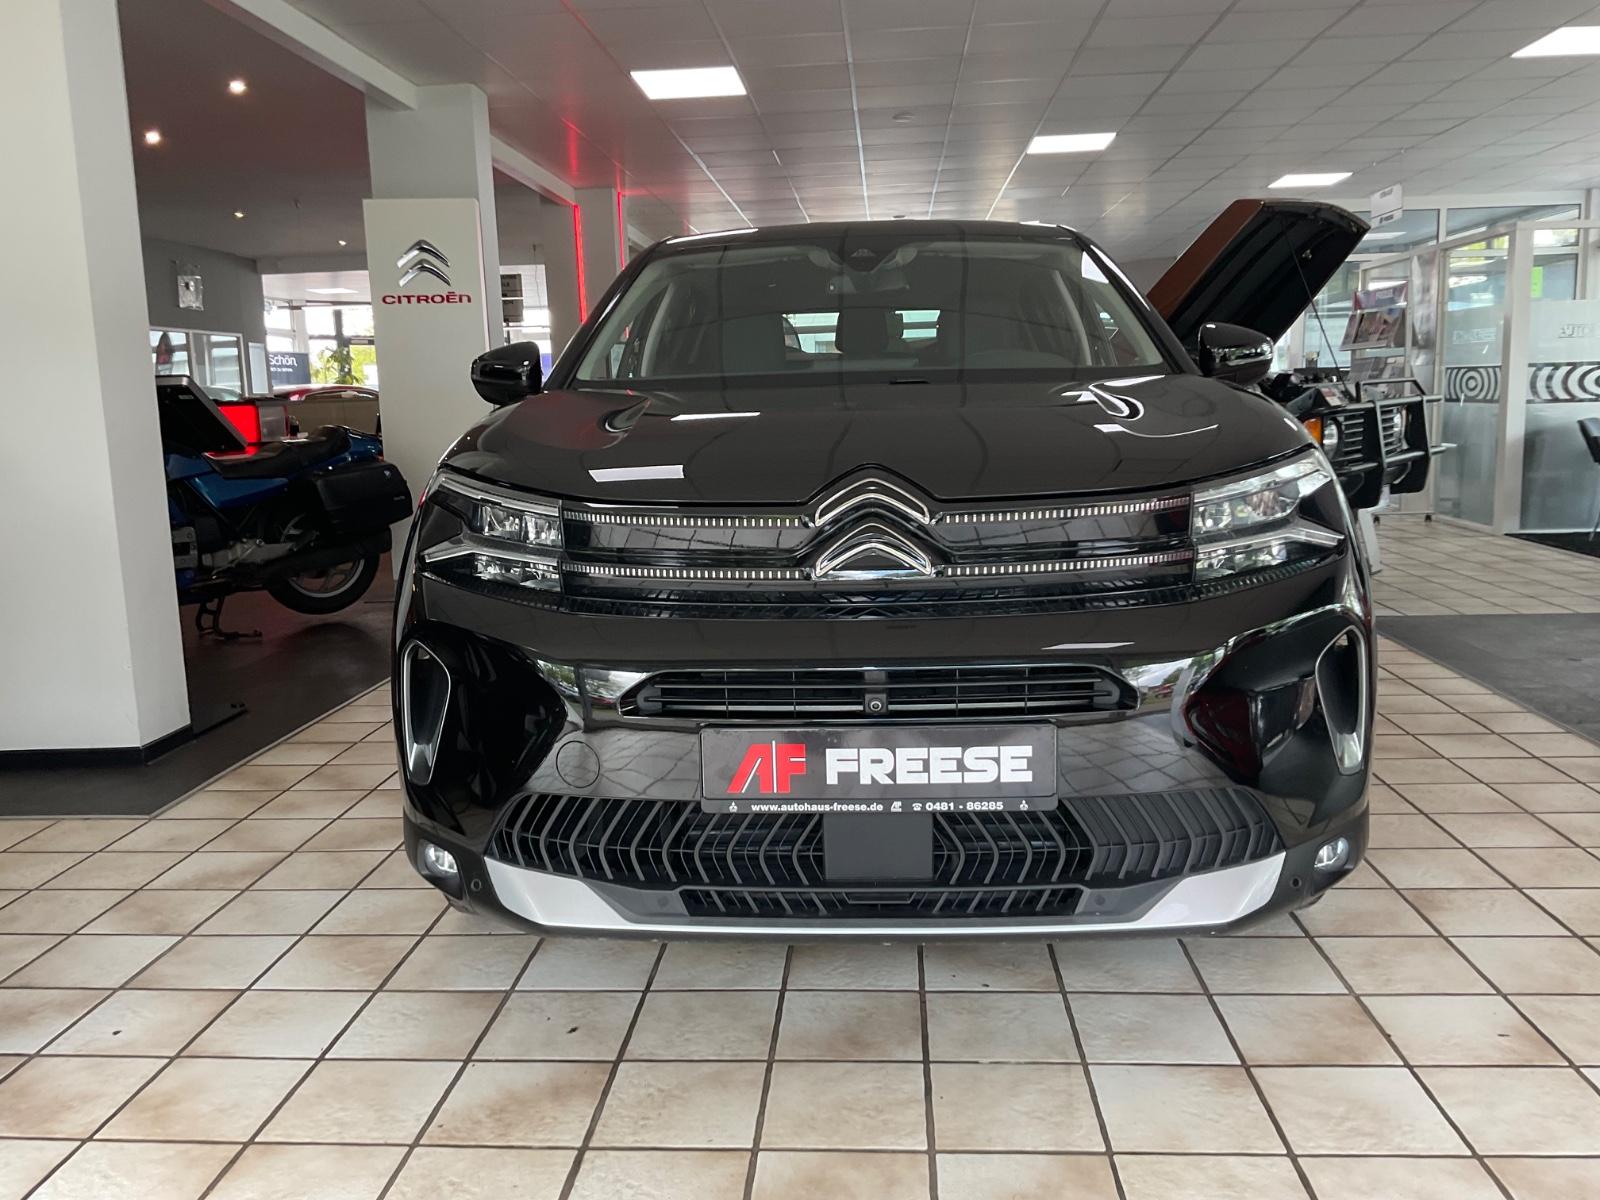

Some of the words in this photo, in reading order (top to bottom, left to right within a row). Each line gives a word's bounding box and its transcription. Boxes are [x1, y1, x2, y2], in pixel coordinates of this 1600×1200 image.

[825, 745, 1034, 785] FREESE
[751, 802, 884, 812] www.autohaus-freese.de
[925, 802, 955, 811] 0481
[966, 801, 1004, 811] 86285
